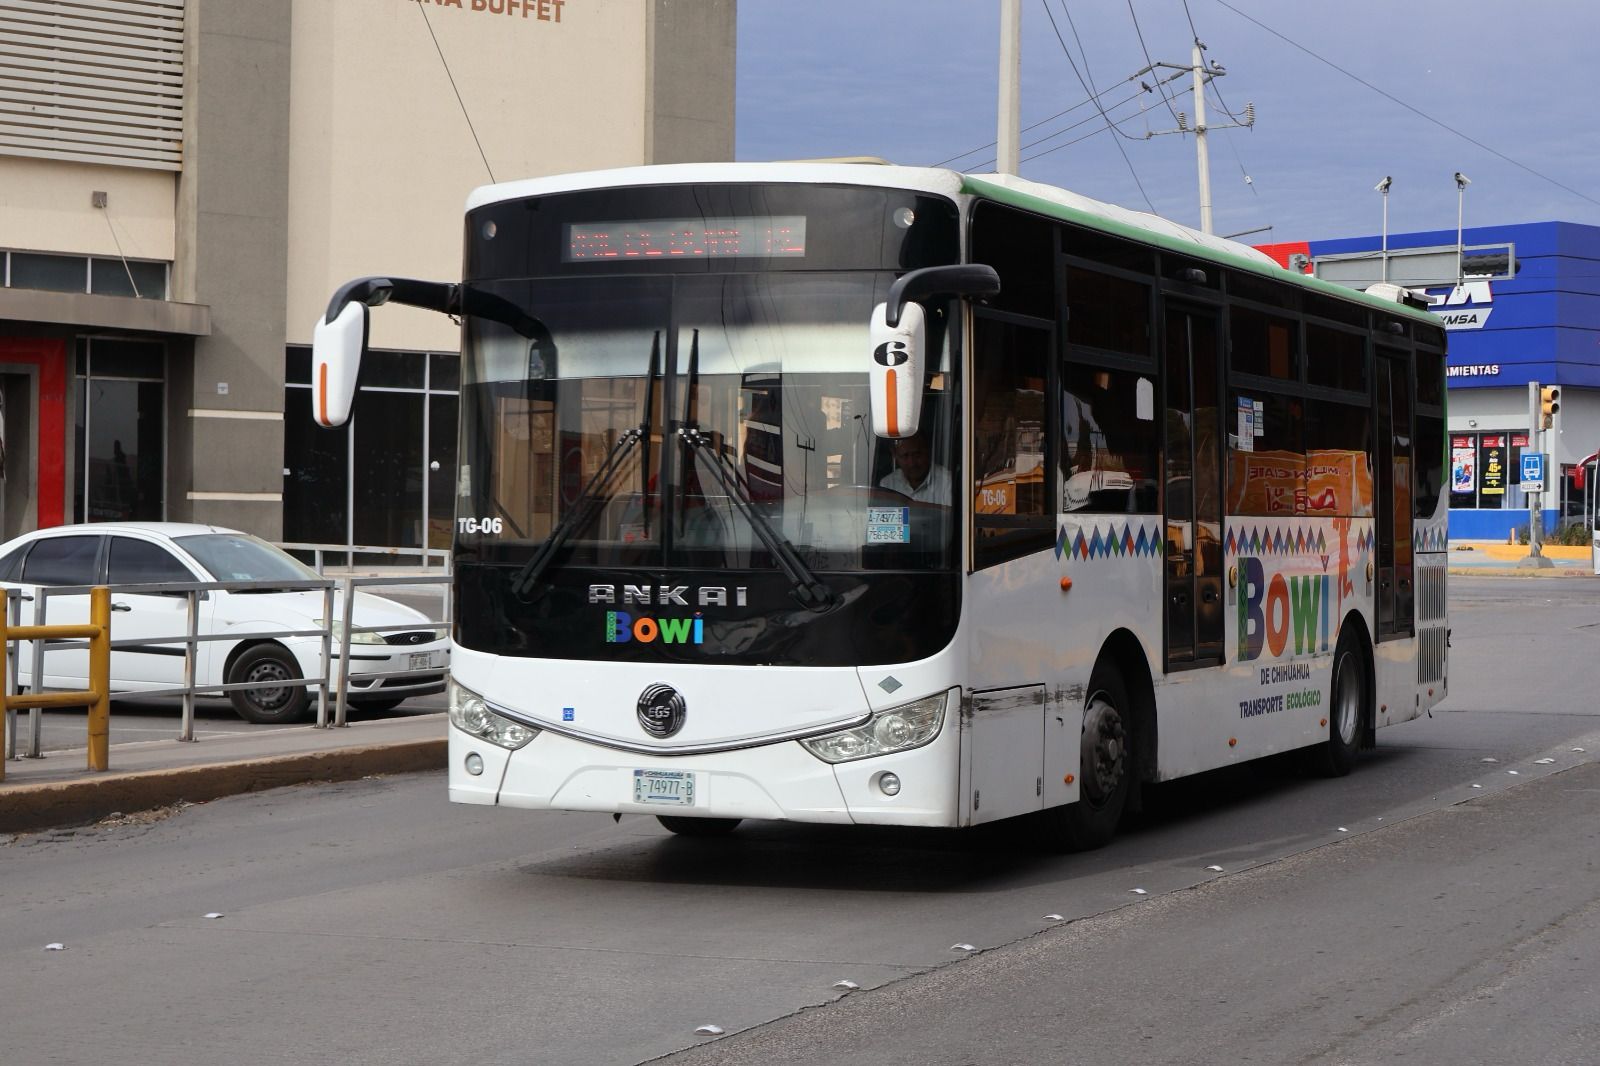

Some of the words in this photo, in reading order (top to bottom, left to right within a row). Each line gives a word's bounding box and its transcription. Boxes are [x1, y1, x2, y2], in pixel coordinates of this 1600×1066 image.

[873, 341, 909, 367] 6
[981, 489, 1007, 506] TG-06
[457, 517, 503, 534] TG-06
[588, 584, 748, 607] ANKAI
[1260, 667, 1270, 686] DE
[1271, 663, 1310, 684] CHIHUAHUA
[1239, 695, 1283, 719] TRANSPORTE
[1286, 688, 1321, 711] ECOLÓGICO
